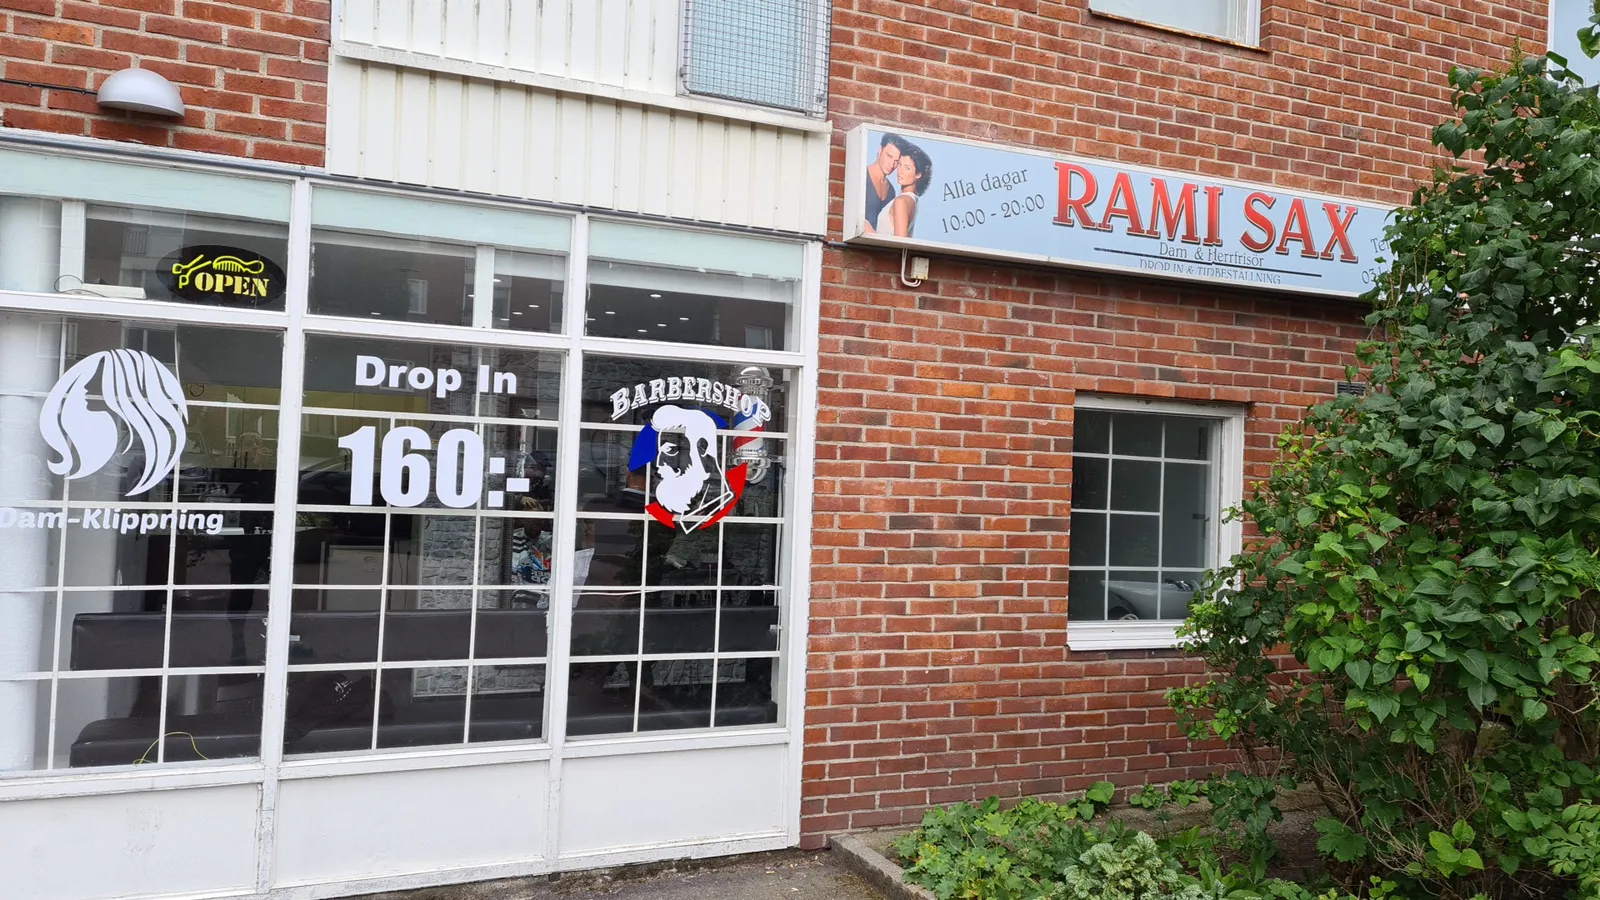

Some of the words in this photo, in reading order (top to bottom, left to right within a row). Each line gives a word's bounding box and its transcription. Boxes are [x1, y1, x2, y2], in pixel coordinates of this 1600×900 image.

[943, 179, 976, 201] Alla
[980, 169, 1028, 191] dagar
[941, 208, 986, 233] 10:00
[1000, 193, 1045, 218] 20:00
[1052, 160, 1223, 245] RAMI
[1240, 190, 1359, 264] SAX
[1140, 259, 1170, 272] DROP
[1173, 263, 1185, 273] IN
[1186, 266, 1195, 275] &
[1159, 242, 1187, 258] Dam
[1194, 246, 1204, 261] &
[1208, 248, 1265, 266] Herrfrisör
[195, 272, 269, 297] OPEN
[355, 355, 462, 398] Drop
[478, 364, 517, 394] In
[609, 376, 771, 427] BARBERSHOP
[338, 425, 530, 508] 160:-
[0, 507, 224, 535] Dam-Klippning
